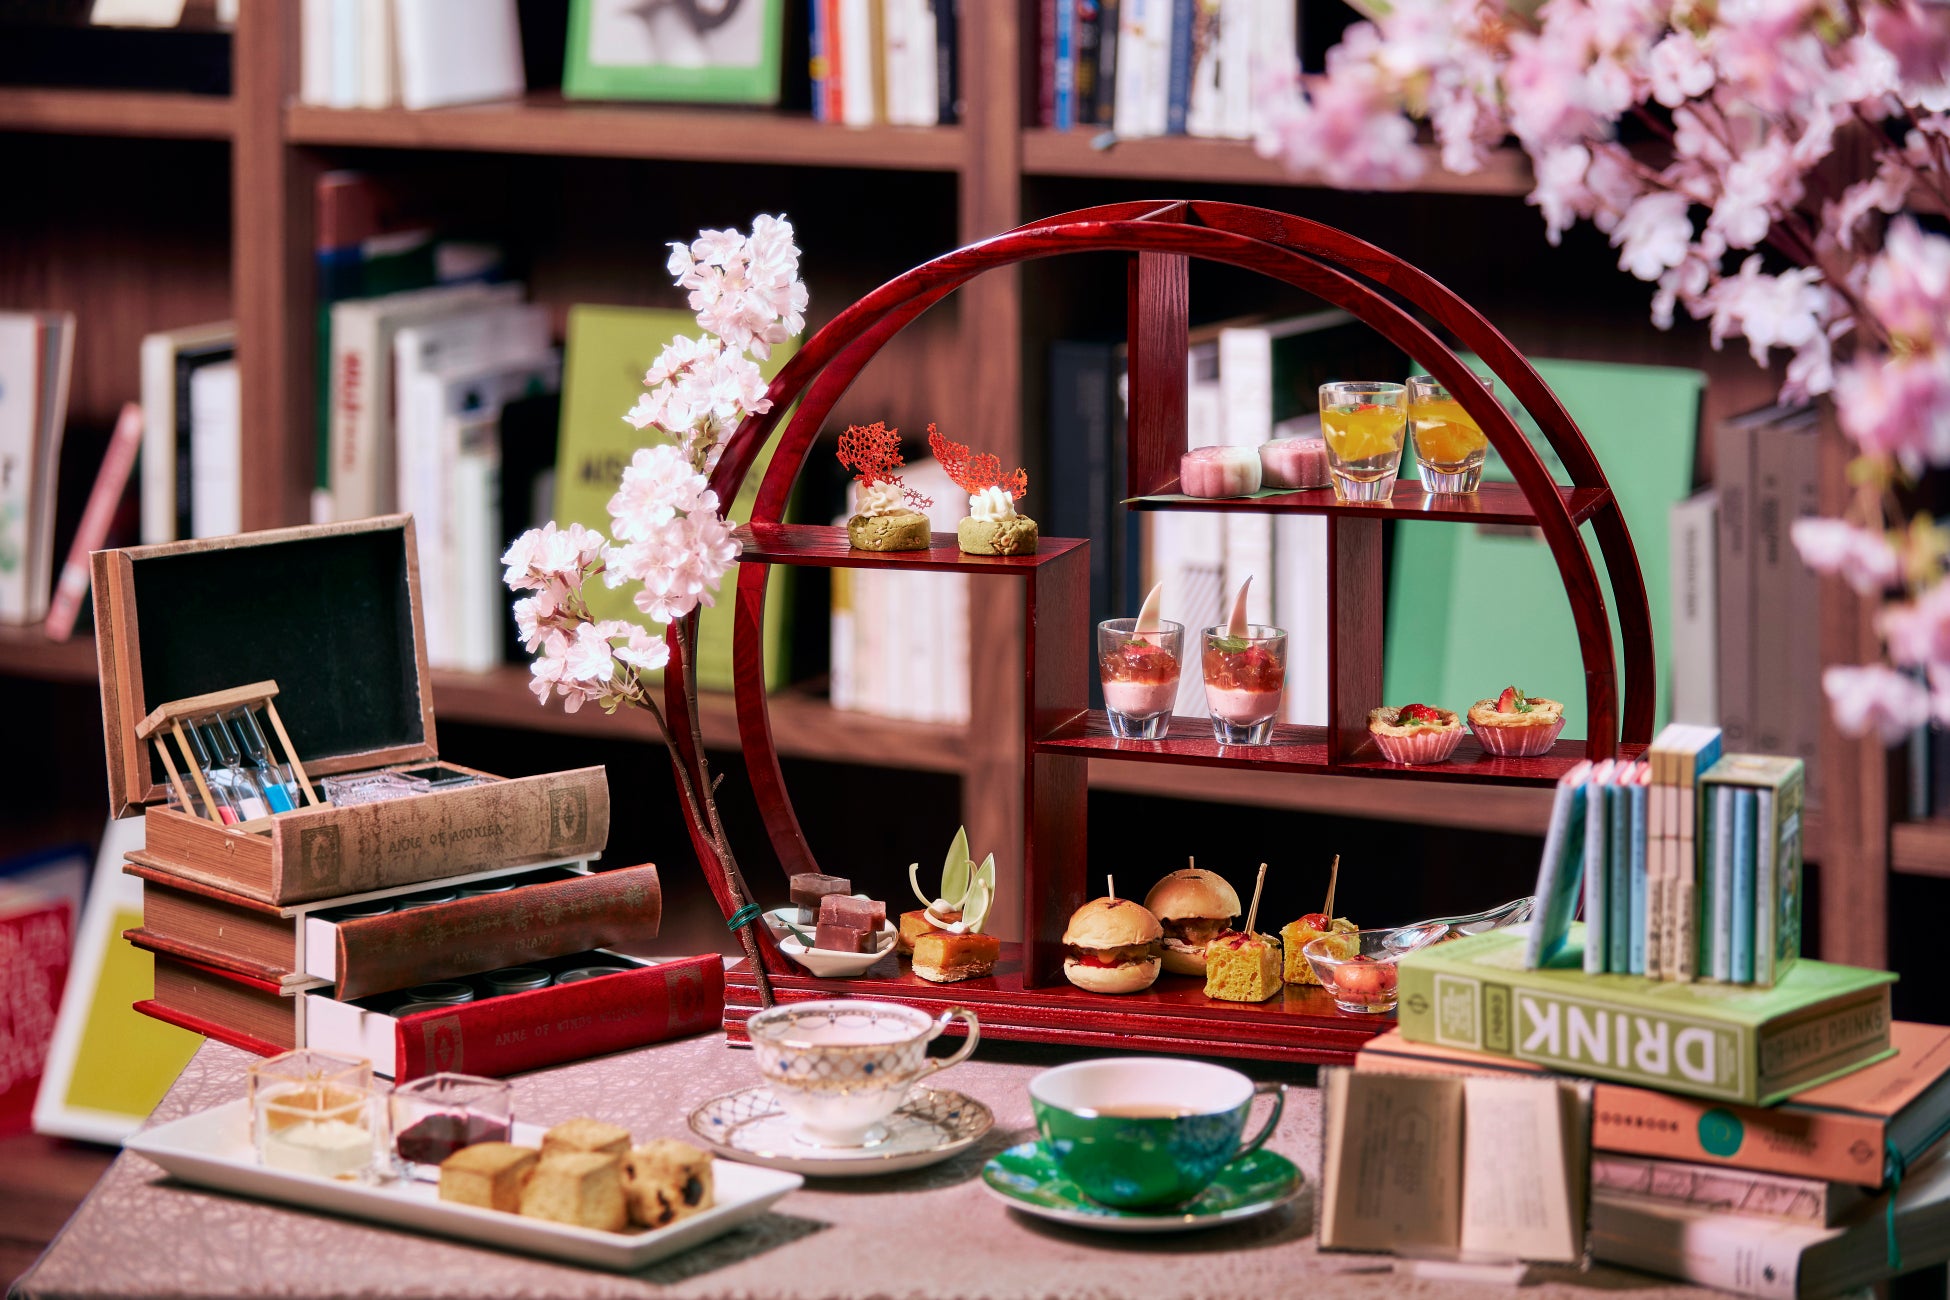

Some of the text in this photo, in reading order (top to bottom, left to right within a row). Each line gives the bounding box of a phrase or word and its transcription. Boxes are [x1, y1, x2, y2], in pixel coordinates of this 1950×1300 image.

[495, 1029, 528, 1046] ANNE
[534, 1024, 550, 1037] OF
[1522, 998, 1716, 1083] DRINK
[1596, 1111, 1679, 1133] OOKBOOK
